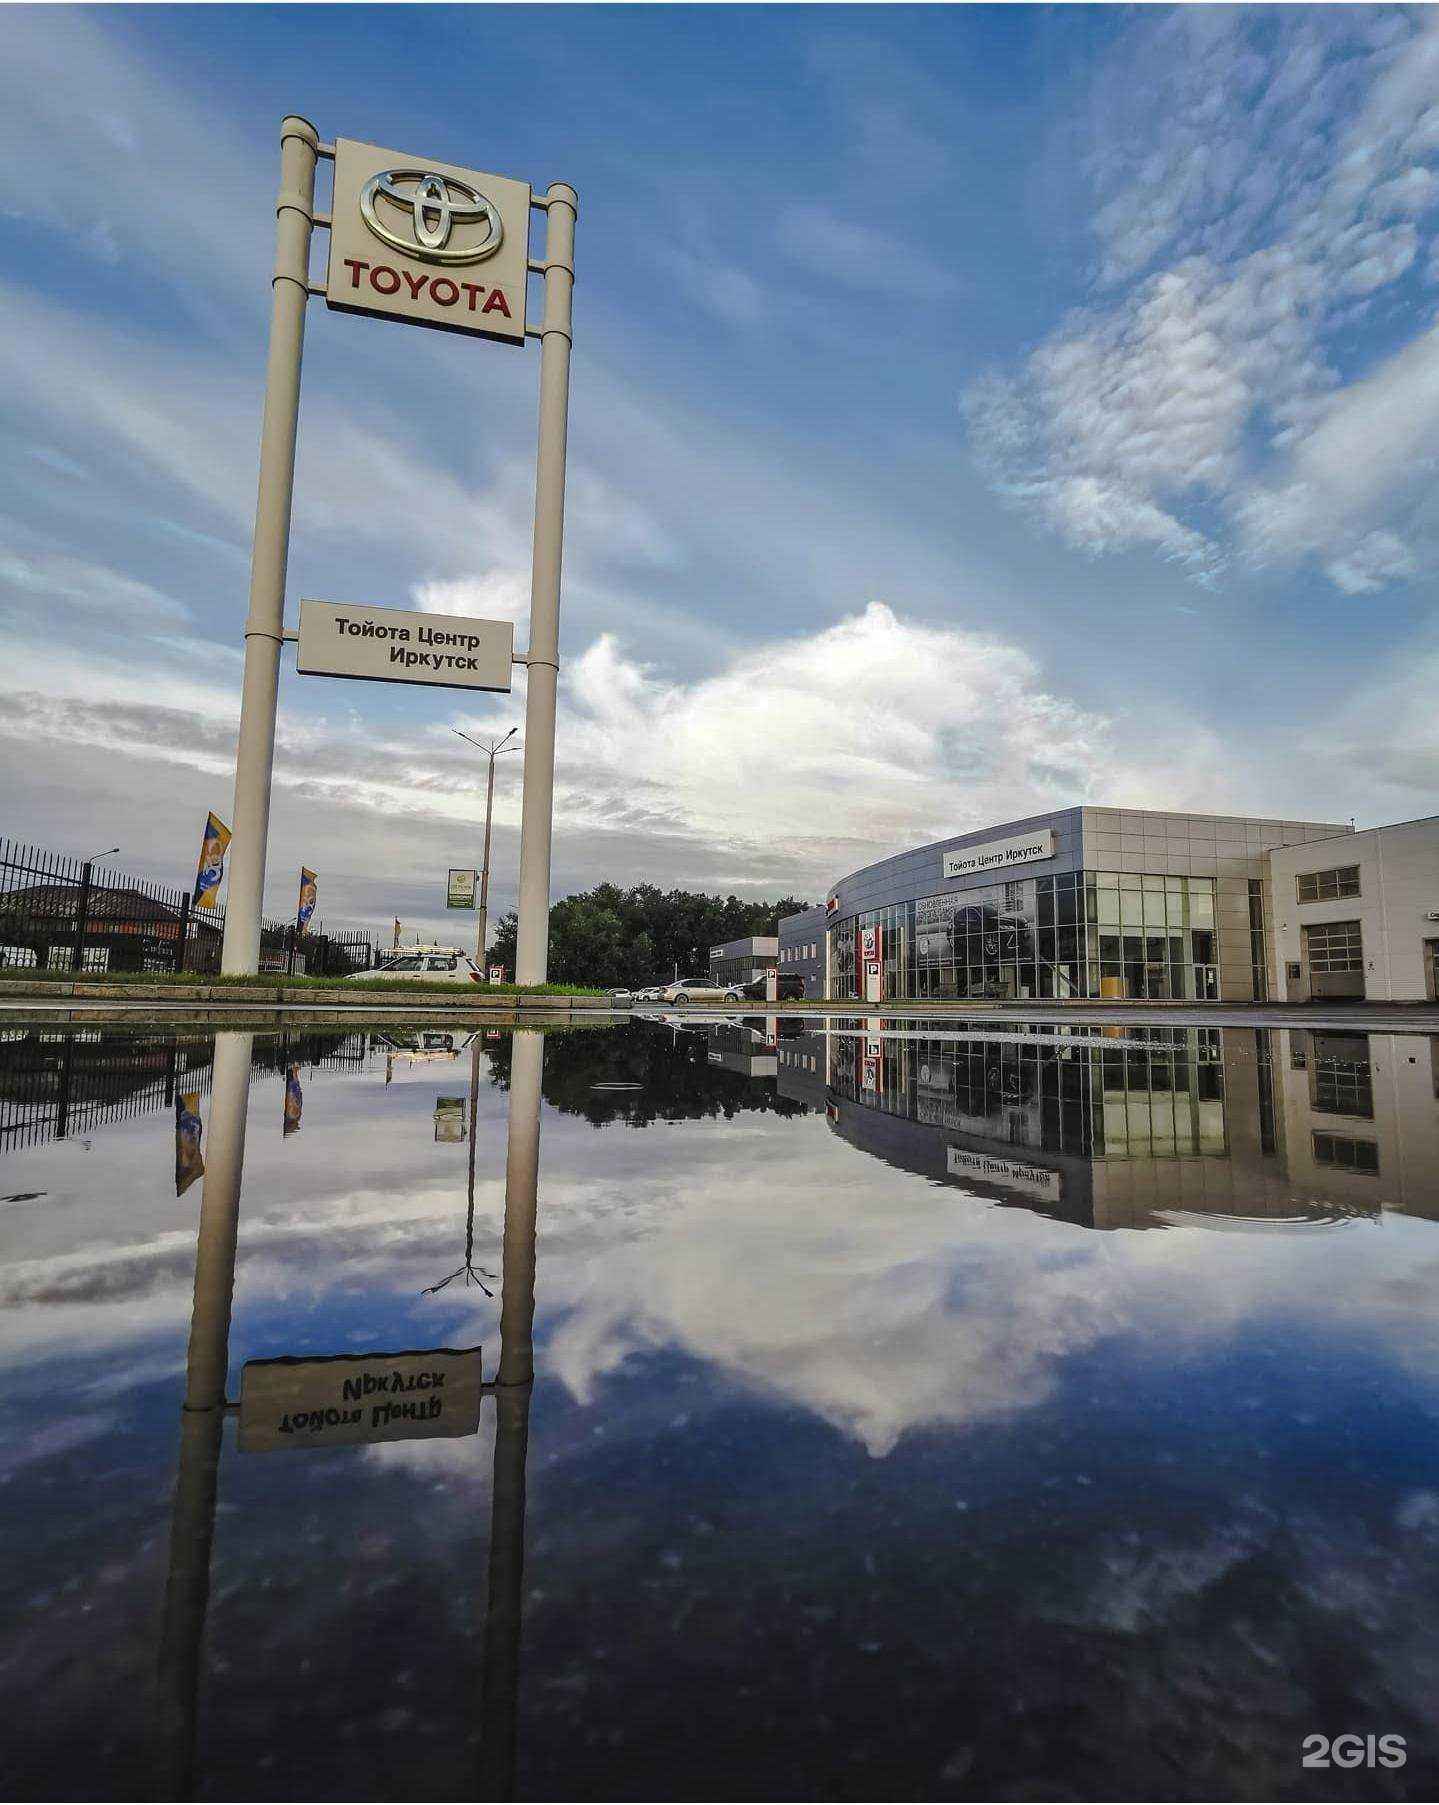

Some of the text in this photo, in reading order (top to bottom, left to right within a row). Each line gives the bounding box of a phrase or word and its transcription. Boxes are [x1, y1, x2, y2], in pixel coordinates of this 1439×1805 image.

[344, 259, 512, 318] TOYOTA
[335, 618, 480, 651] Тойота Центр
[389, 647, 479, 671] Иркутск
[949, 845, 1043, 872] Тойота Центр Иркутск
[870, 965, 878, 974] P
